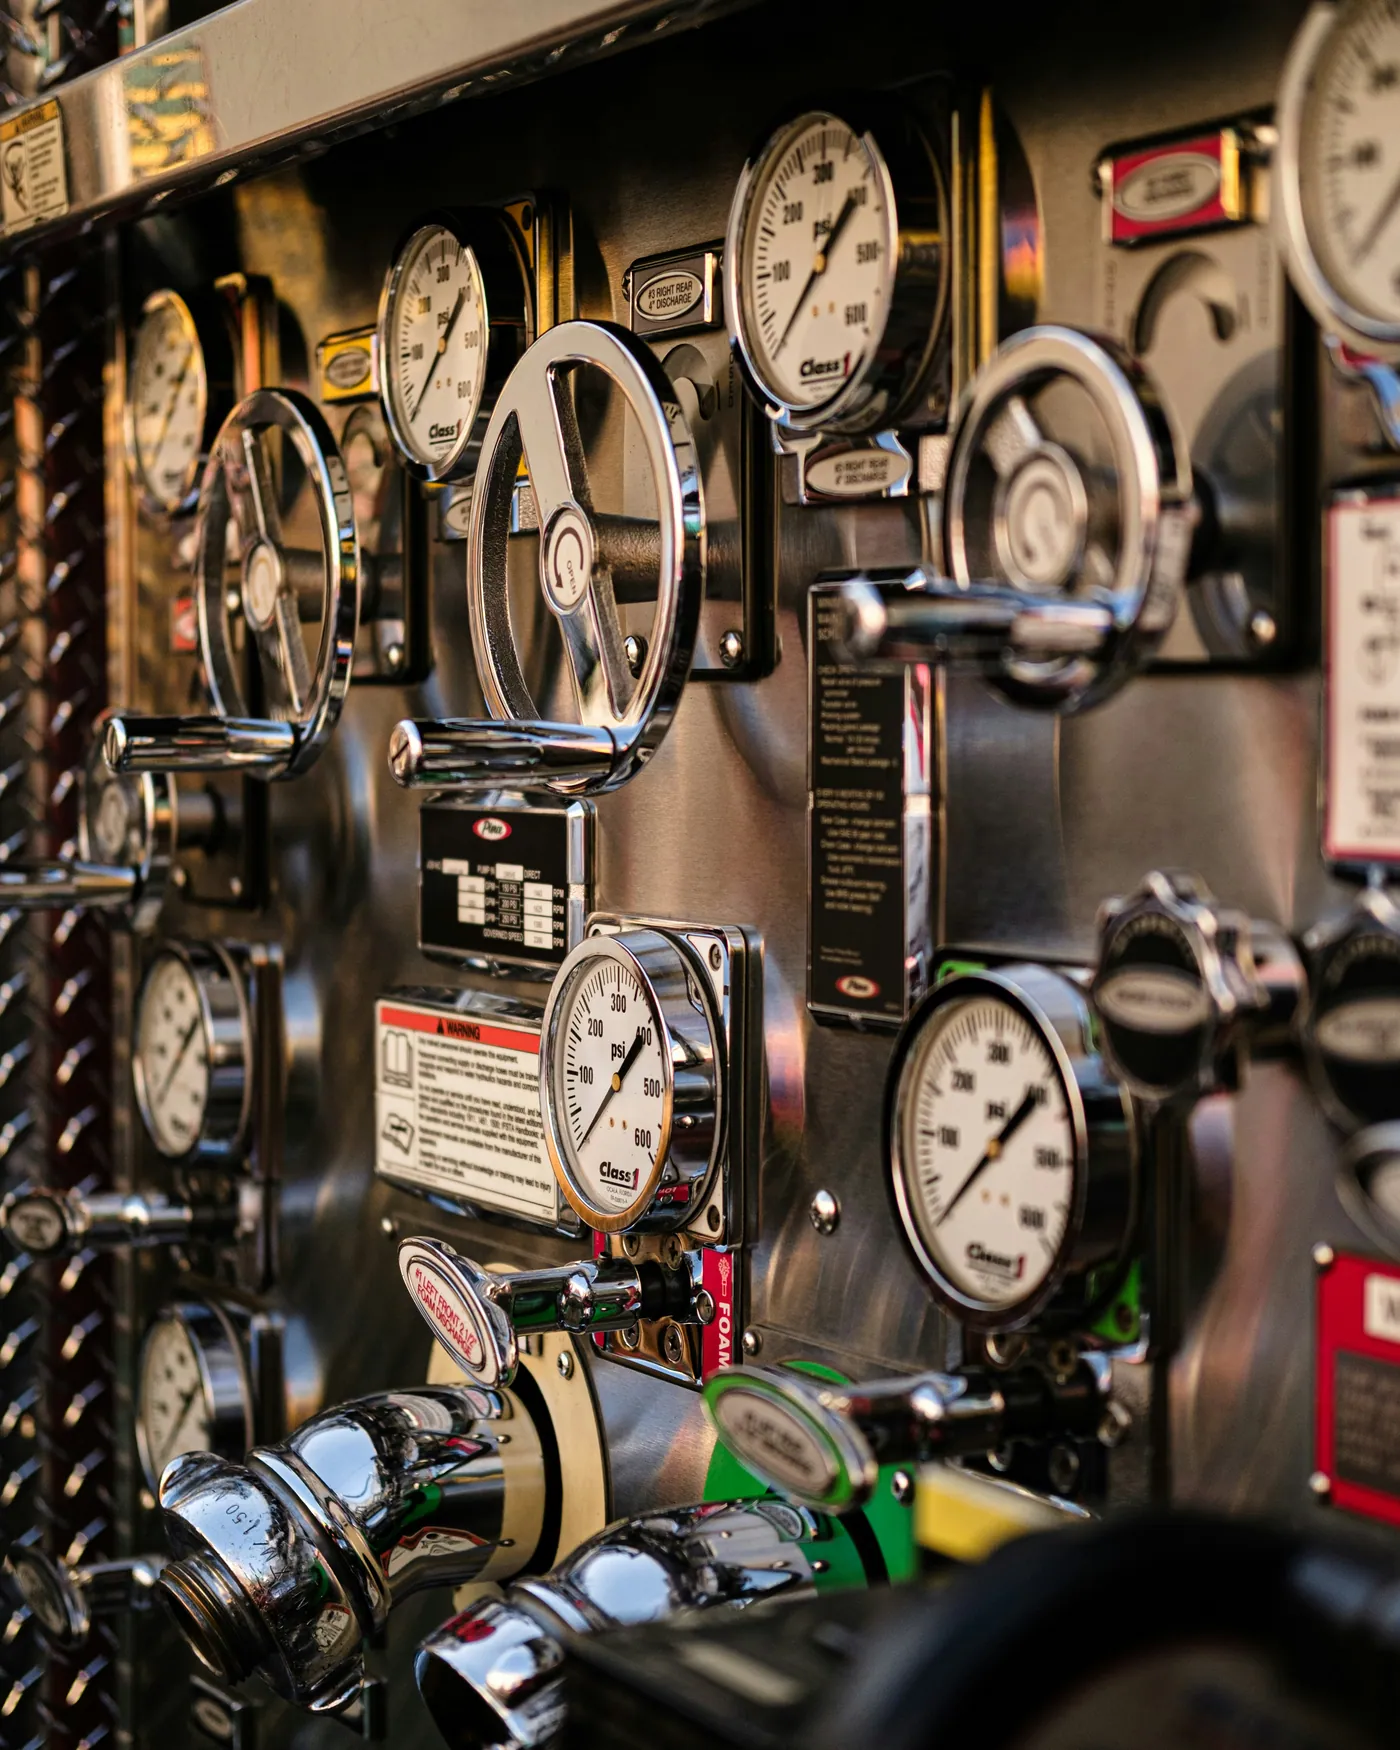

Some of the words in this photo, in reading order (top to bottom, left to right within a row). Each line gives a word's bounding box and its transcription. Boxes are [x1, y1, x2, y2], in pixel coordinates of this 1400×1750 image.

[813, 162, 834, 185] 300
[783, 202, 802, 225] 200
[813, 213, 831, 241] psi
[856, 240, 878, 264] 500
[436, 265, 450, 283] 300
[772, 261, 790, 282] 100
[648, 289, 655, 299] #3
[656, 284, 675, 298] RIGHT
[676, 281, 692, 291] REAR
[418, 297, 431, 315] 200
[657, 293, 692, 309] DISCHARGE
[437, 307, 450, 329] psi
[845, 303, 866, 326] 600
[464, 330, 478, 348] 500
[411, 344, 423, 360] 100
[457, 381, 472, 399] 600
[566, 560, 577, 595] OPEN
[524, 869, 541, 880] DIRECT
[553, 888, 564, 898] RPM
[553, 905, 564, 914] RPM
[553, 921, 564, 931] RPM
[553, 938, 564, 947] RPM
[610, 993, 627, 1013] 300
[446, 1020, 481, 1040] WARNING
[587, 1017, 604, 1038] 200
[611, 1041, 625, 1060] psi
[579, 1067, 593, 1085] 100
[643, 1079, 660, 1098] 500
[527, 1108, 535, 1116] and
[634, 1128, 651, 1149] 600
[415, 1268, 423, 1278] #1
[423, 1276, 438, 1297] LEFT
[440, 1292, 459, 1326] FRONT
[417, 1284, 435, 1314] FOAM
[435, 1308, 472, 1360] DISCHARGE
[719, 1302, 731, 1370] FOAM
